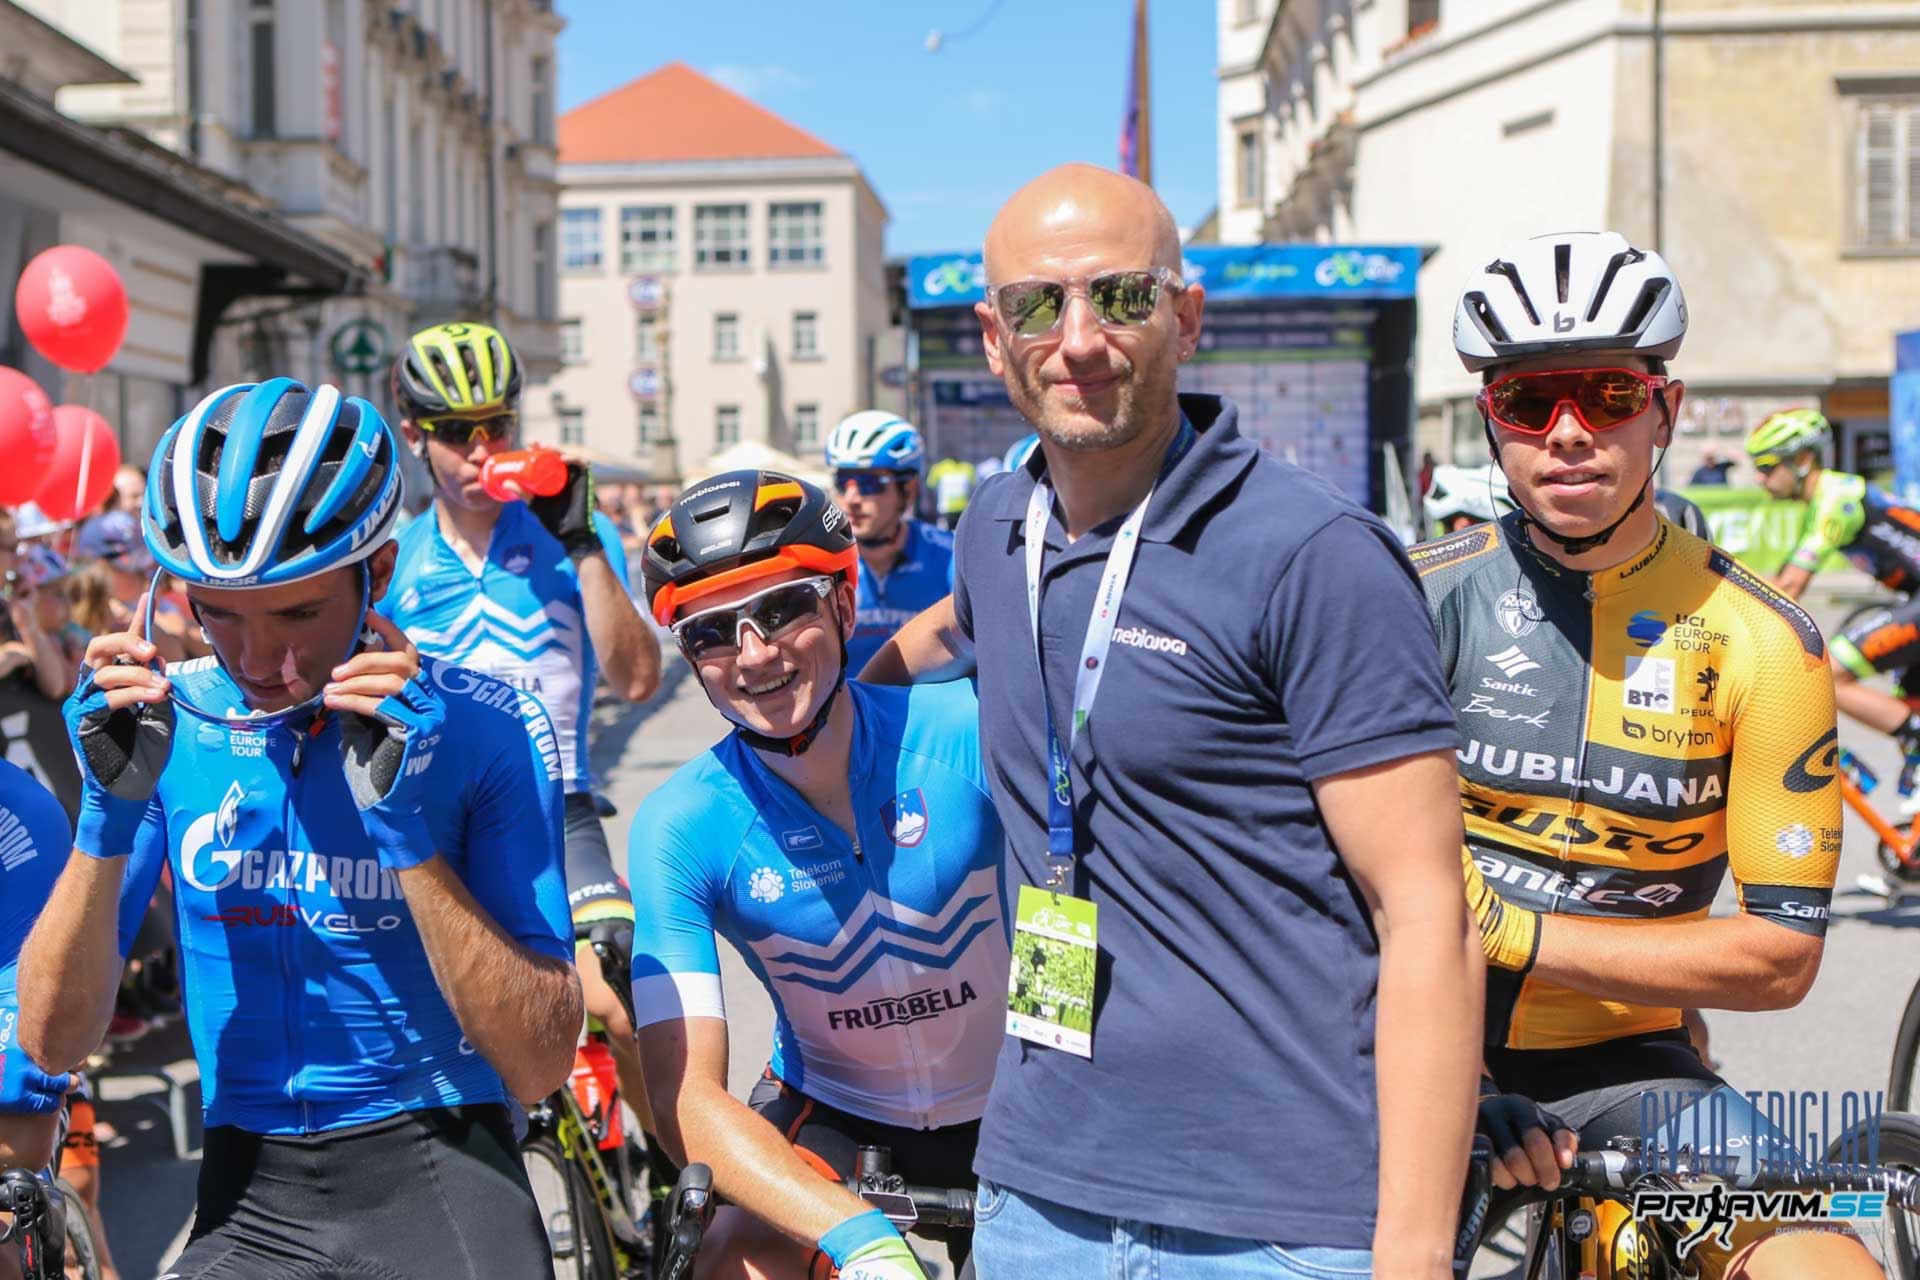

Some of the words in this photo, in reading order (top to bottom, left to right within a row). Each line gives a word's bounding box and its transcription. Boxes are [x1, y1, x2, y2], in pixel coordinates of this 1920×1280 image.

[1675, 613, 1705, 628] UCI
[1673, 626, 1729, 647] EUROPE
[1674, 639, 1711, 655] TOUR
[1479, 677, 1539, 698] Santic
[1627, 688, 1669, 708] BTC
[1460, 692, 1551, 730] Berk
[230, 734, 278, 748] EUROPE
[1652, 723, 1715, 749] bryton
[231, 745, 263, 758] TOUR
[1456, 739, 1723, 808] JUBLJANA
[788, 860, 842, 881] Telekom
[1471, 853, 1627, 905] antic
[790, 872, 846, 894] Slovenije
